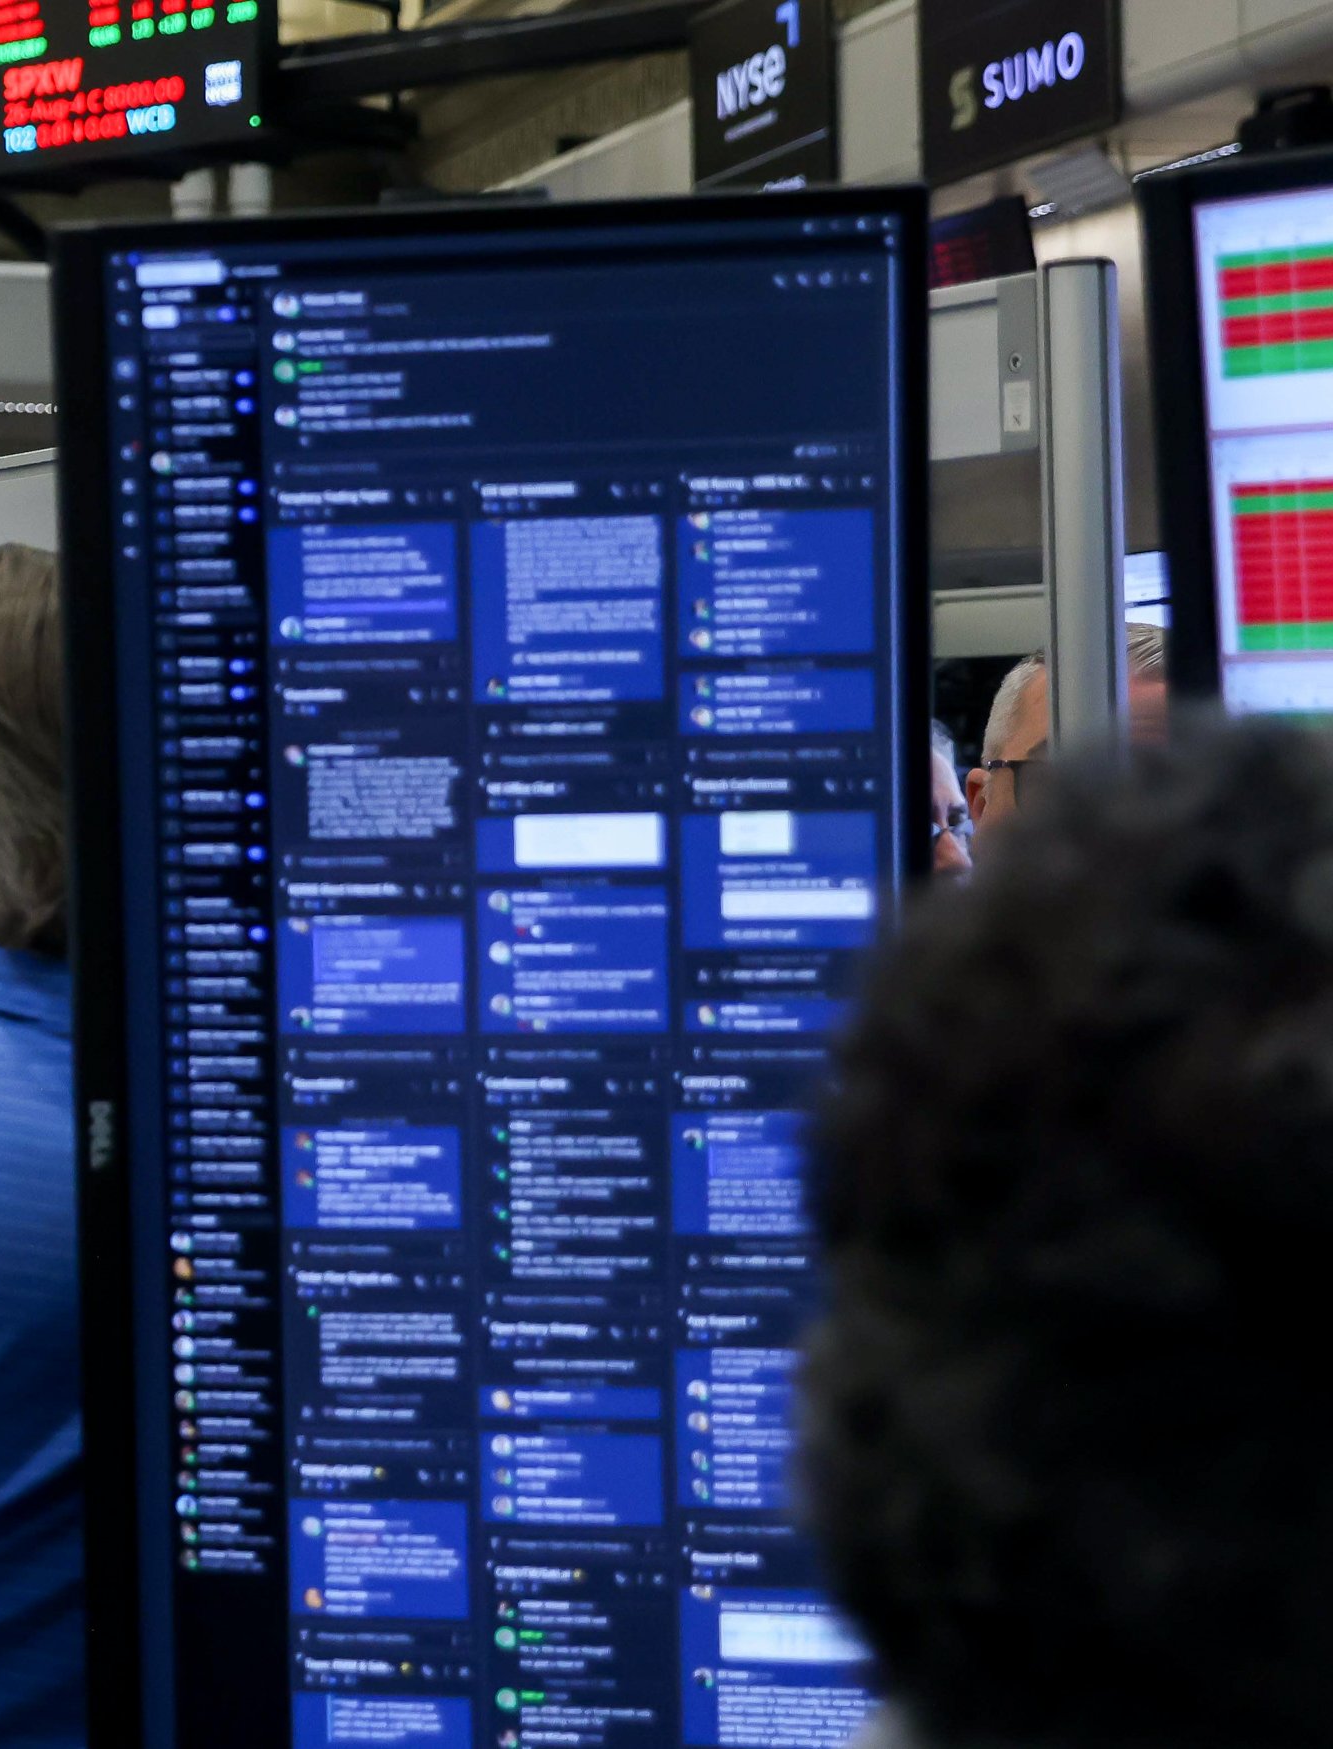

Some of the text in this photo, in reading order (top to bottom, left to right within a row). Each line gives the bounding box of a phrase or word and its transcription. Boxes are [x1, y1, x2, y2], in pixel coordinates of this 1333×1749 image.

[4, 57, 84, 101] SPXW
[983, 31, 1085, 109] SUMO
[4, 124, 37, 153] 102
[126, 104, 176, 135] WCB
